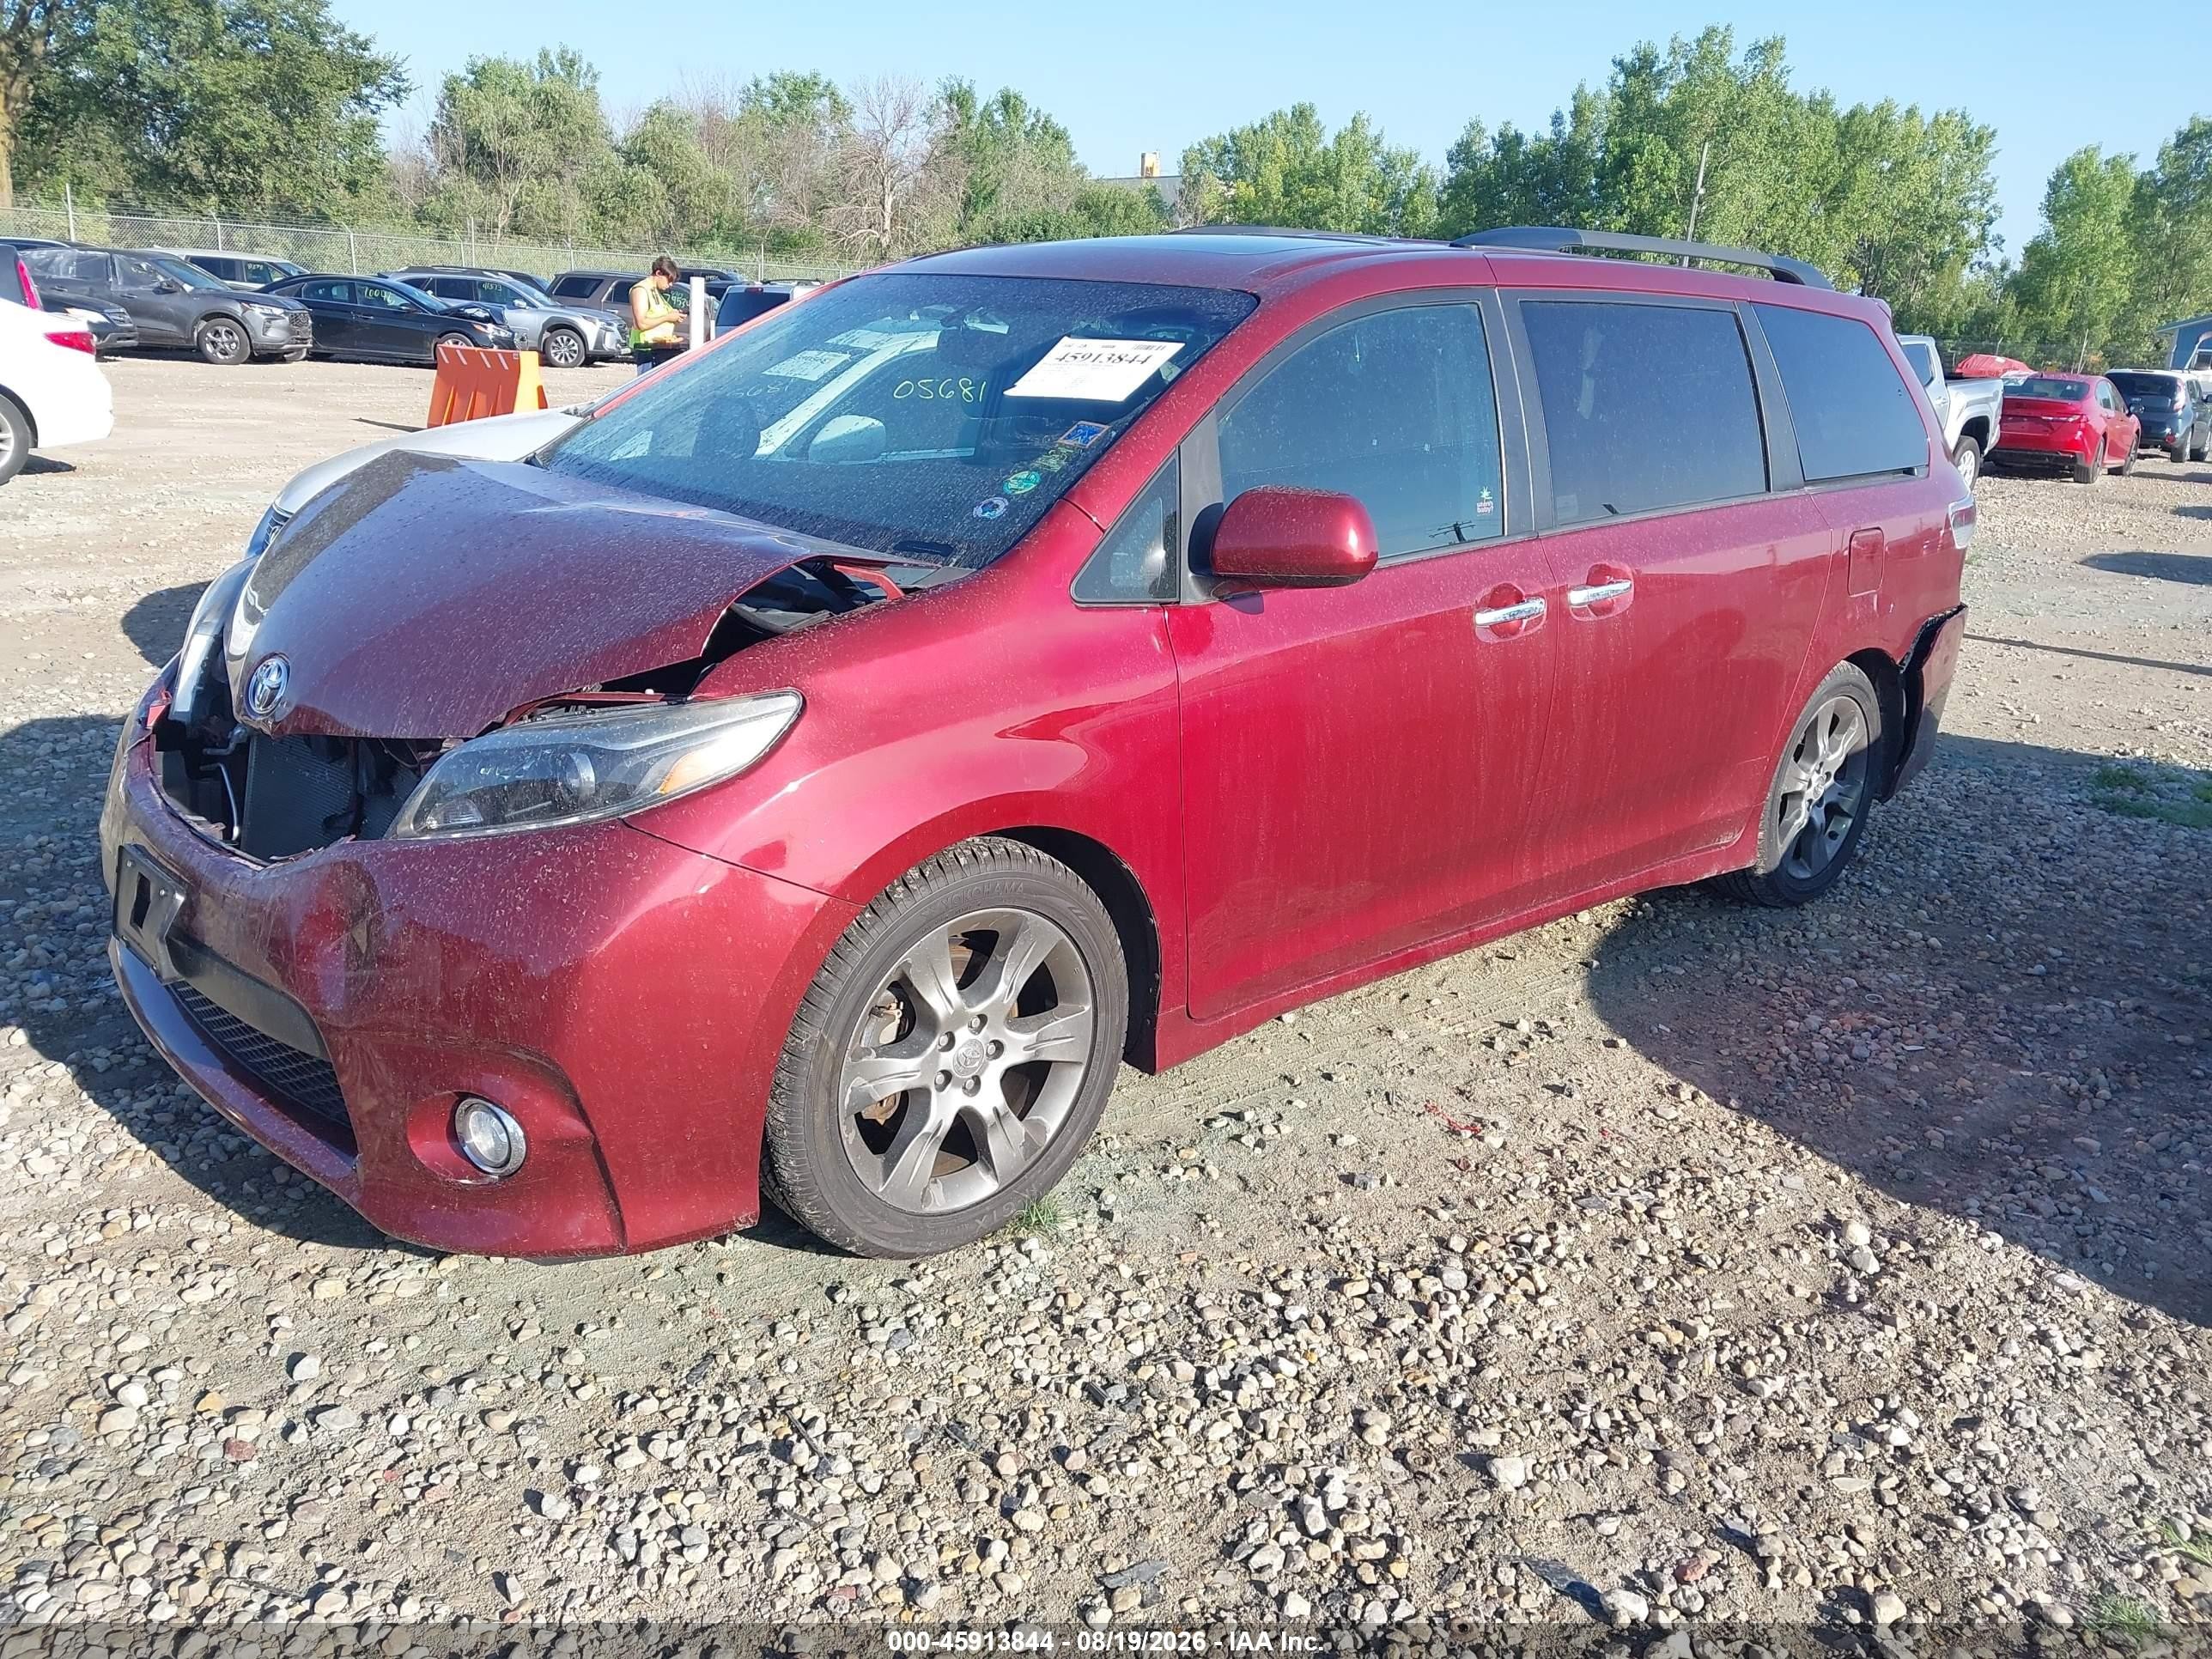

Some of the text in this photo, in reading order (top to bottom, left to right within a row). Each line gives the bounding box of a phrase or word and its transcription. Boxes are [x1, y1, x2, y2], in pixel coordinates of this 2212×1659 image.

[1054, 352, 1153, 364] 45913844
[893, 378, 987, 403] 05681
[941, 881, 1024, 908] YOKOHAMA
